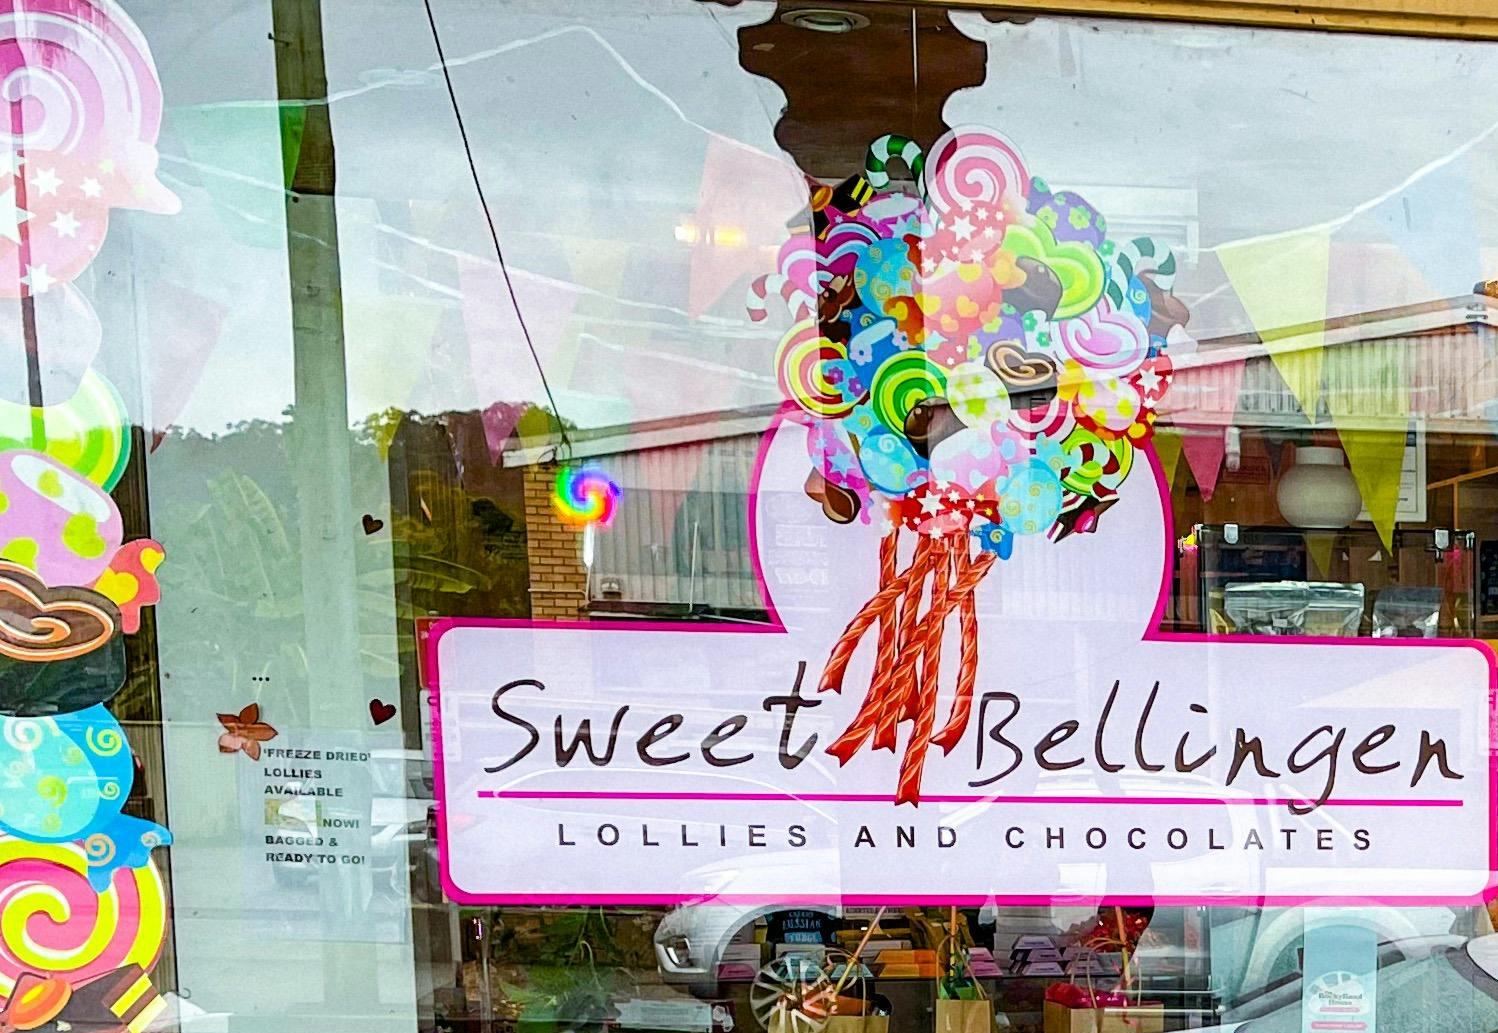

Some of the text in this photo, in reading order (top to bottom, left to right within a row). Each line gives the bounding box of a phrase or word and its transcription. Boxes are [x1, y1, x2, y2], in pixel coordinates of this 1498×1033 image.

[483, 660, 1464, 815] Sweet Bellingen
[263, 767, 323, 779] LOLLIES
[265, 835, 339, 847] BAGGED &
[557, 823, 1376, 853] LOLLIES AND CHOCOLATES
[265, 853, 314, 864] READY
[318, 854, 337, 864] TO
